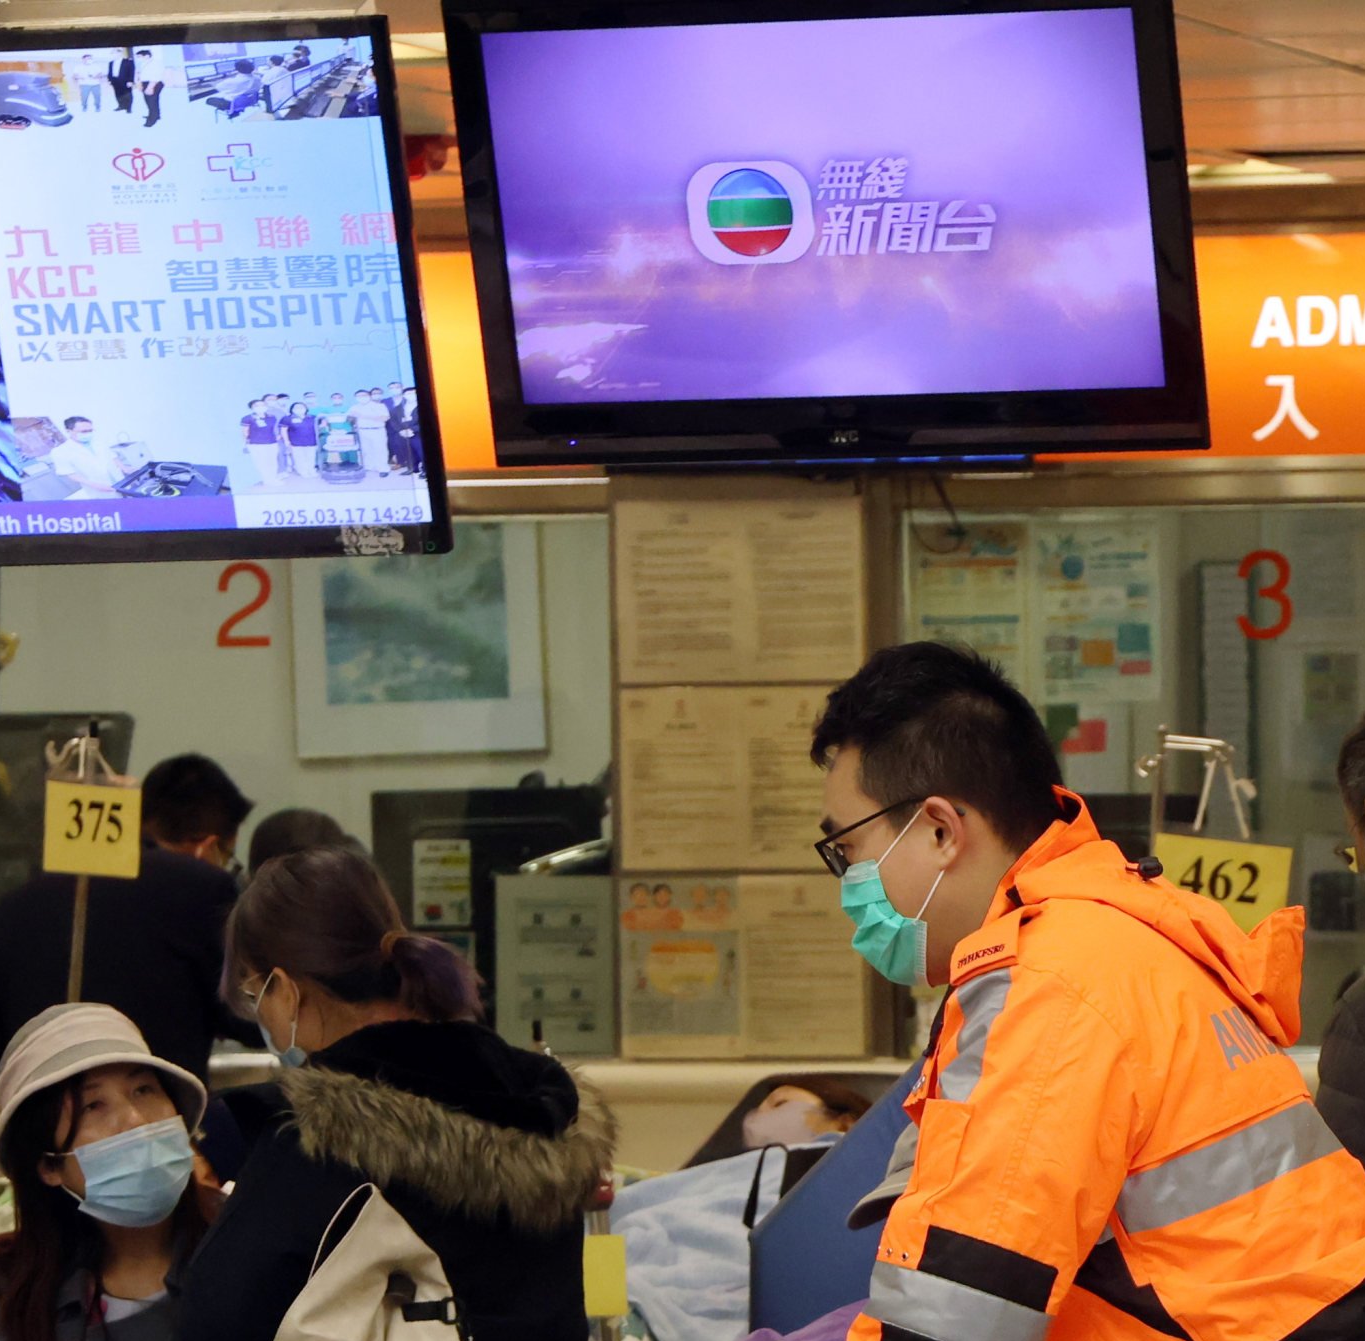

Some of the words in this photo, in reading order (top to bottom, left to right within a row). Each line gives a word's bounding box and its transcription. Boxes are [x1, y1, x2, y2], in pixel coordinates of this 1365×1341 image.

[816, 156, 910, 201] 無綫
[4, 212, 397, 259] 九龍中聯網
[816, 199, 998, 257] 新聞台
[7, 264, 98, 300] KCC
[166, 252, 403, 294] 智慧醫院
[14, 299, 167, 337] SMART
[185, 290, 407, 332] HOSPITAL
[26, 511, 122, 536] Hospital
[262, 507, 366, 527] 2025.03.17
[372, 505, 425, 523] 14:29
[217, 562, 272, 648] 2
[1236, 549, 1294, 640] 3
[65, 798, 123, 843] 375
[1179, 855, 1260, 904] 462
